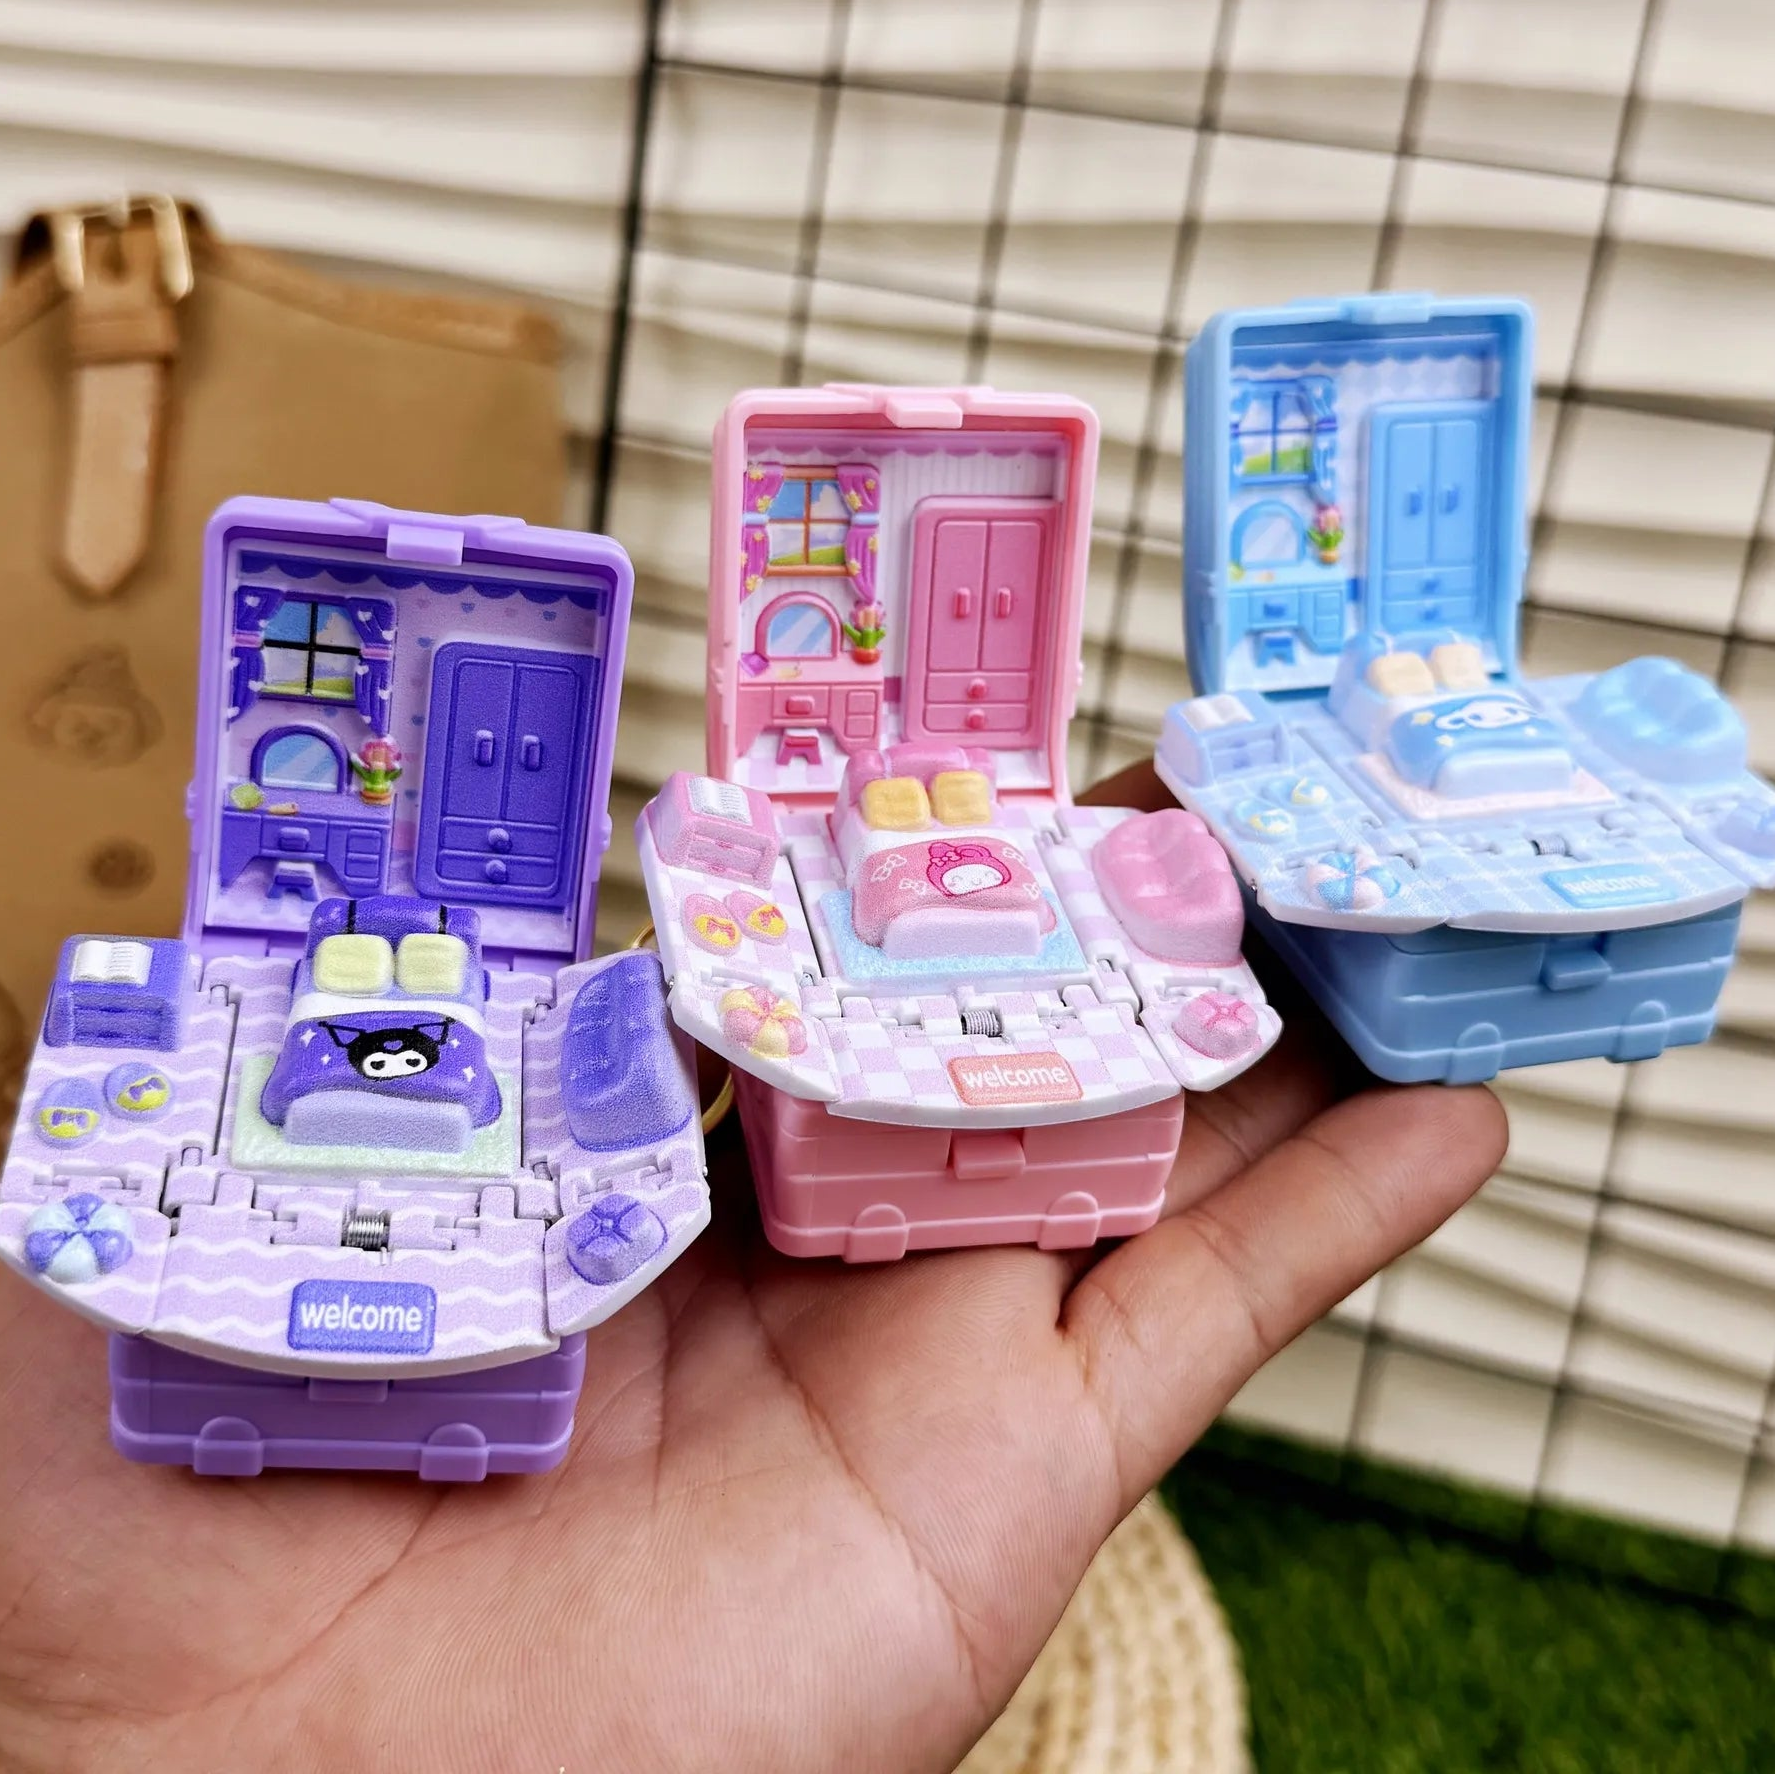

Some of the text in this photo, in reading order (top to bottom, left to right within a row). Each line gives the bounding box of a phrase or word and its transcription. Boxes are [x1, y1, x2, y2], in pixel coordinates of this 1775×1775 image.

[1563, 875, 1660, 895] welcome
[962, 1065, 1068, 1088] welcome
[300, 1294, 423, 1332] welcome
